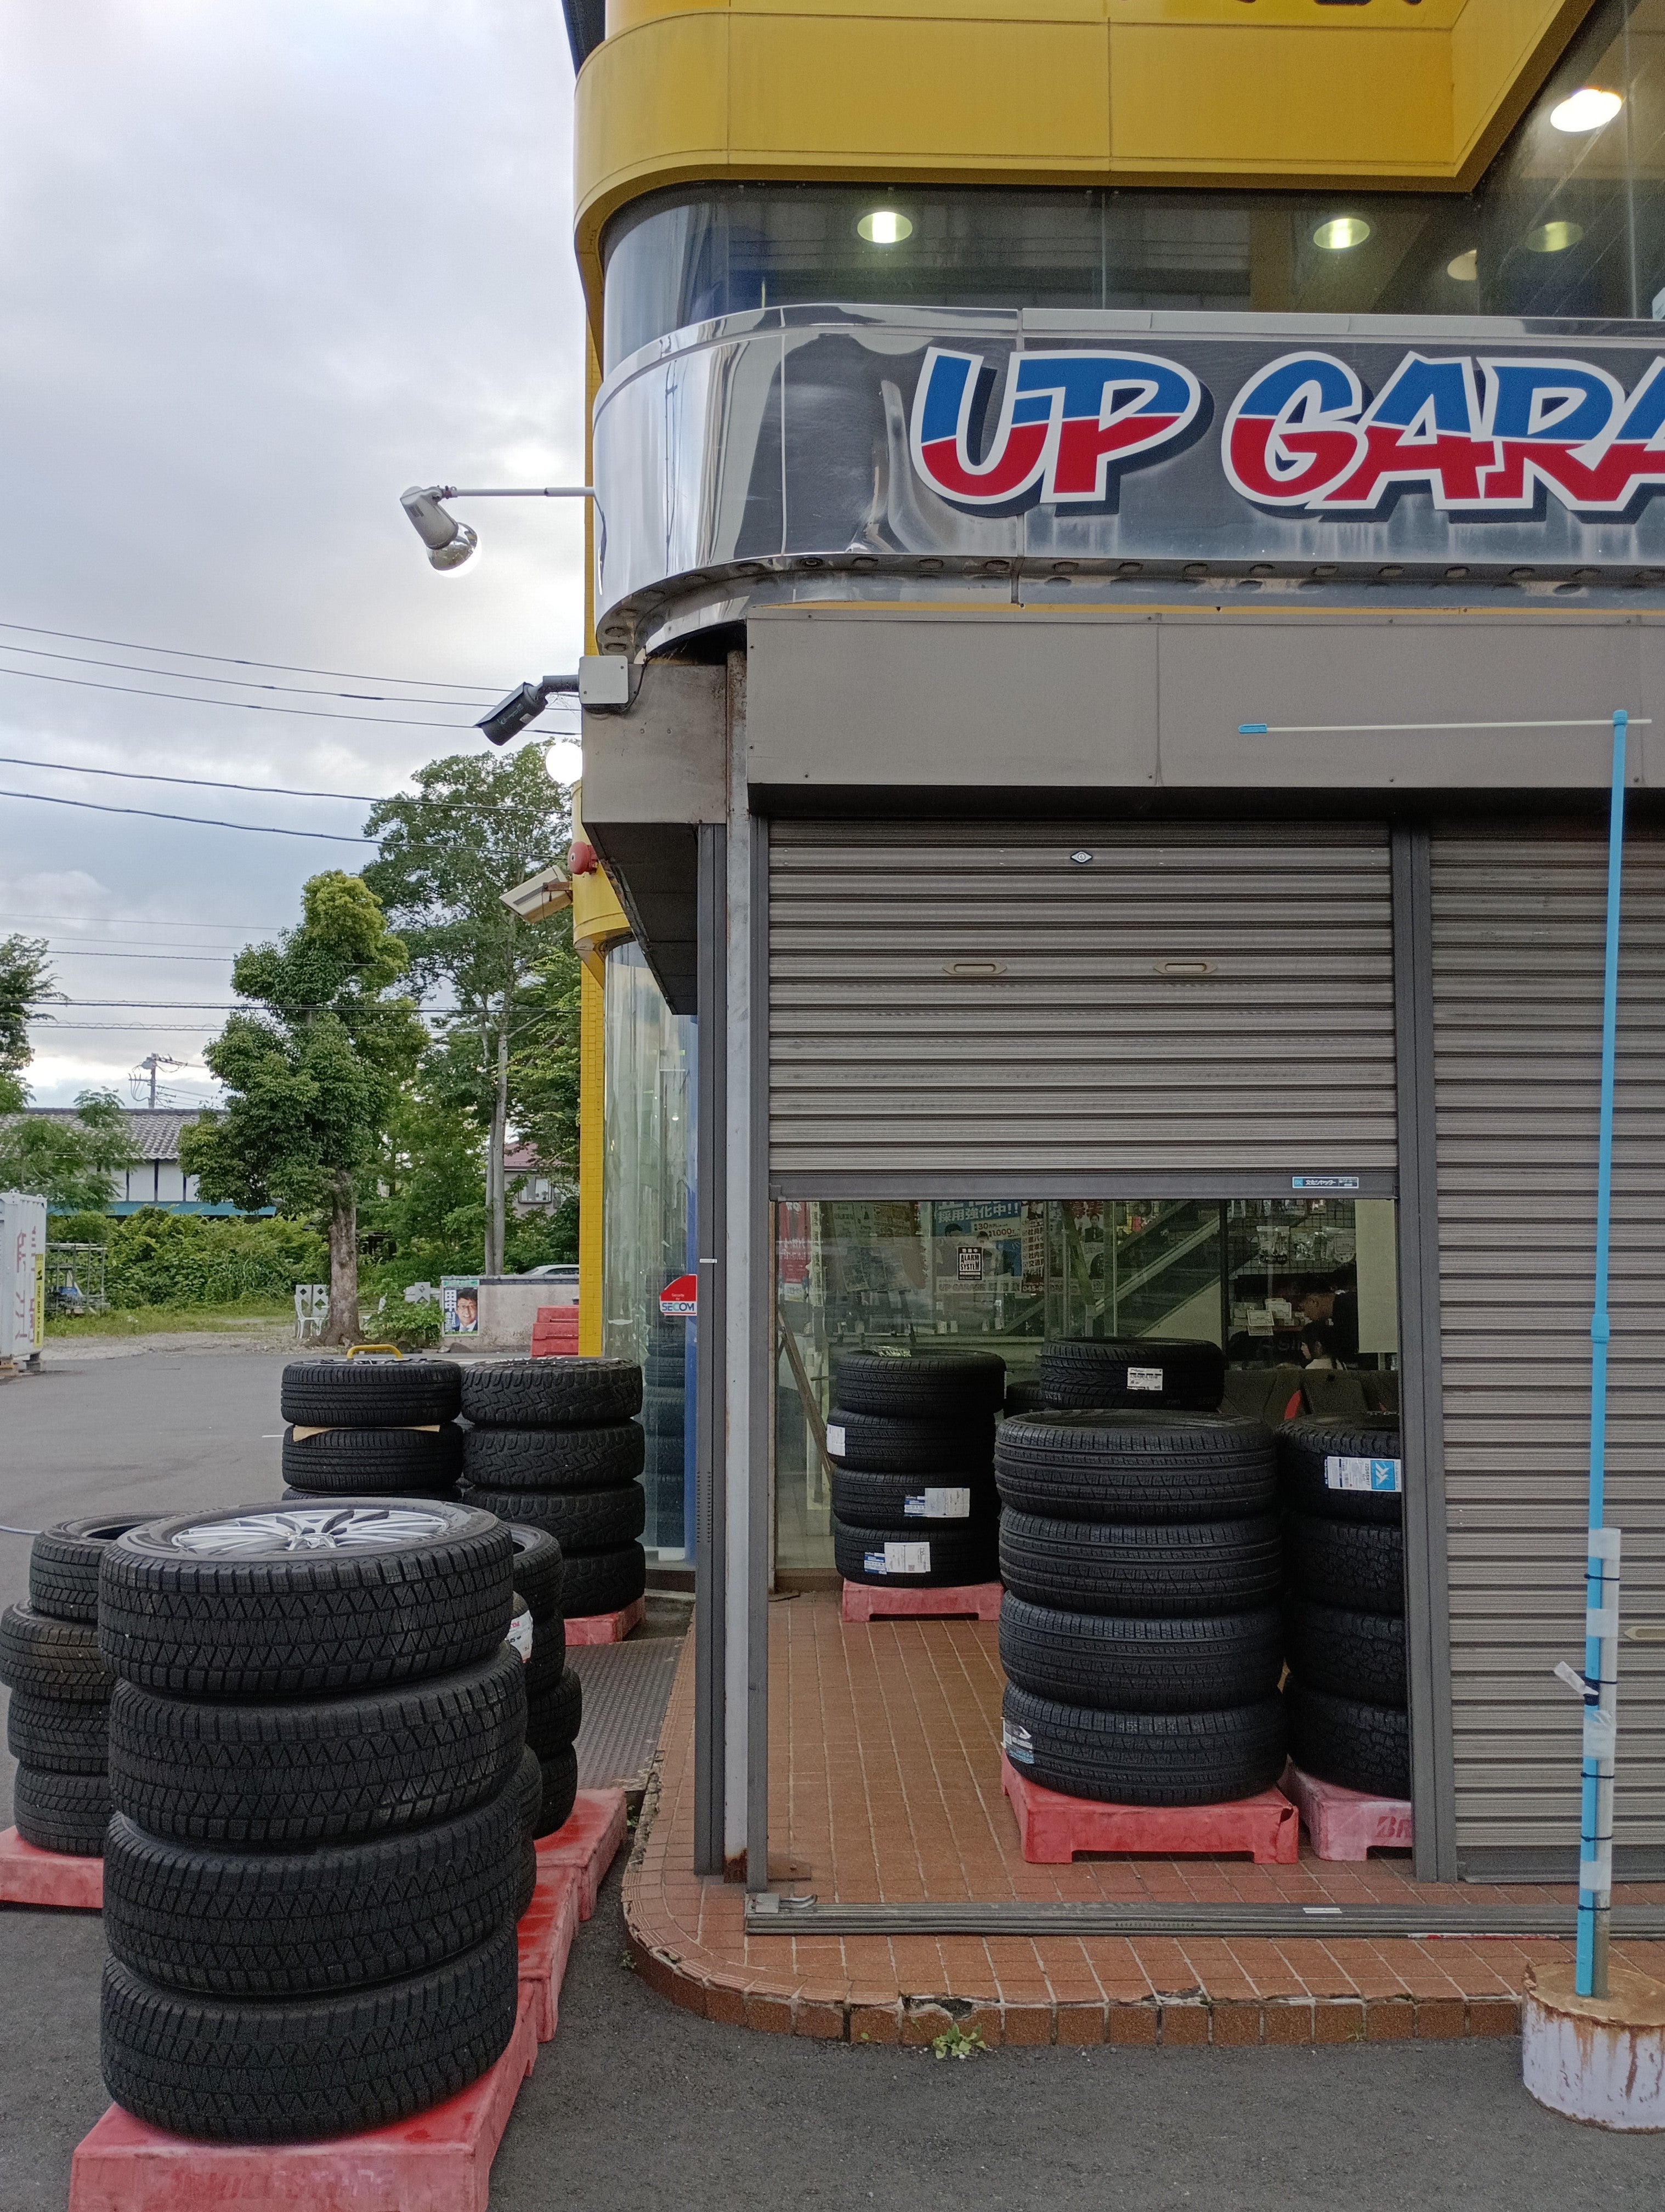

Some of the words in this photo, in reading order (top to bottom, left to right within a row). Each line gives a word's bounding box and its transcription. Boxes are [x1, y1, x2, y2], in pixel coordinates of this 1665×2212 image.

[909, 346, 1203, 505] UP
[961, 1254, 979, 1263] ALARM
[960, 1261, 979, 1270] SYSTEM
[662, 1302, 694, 1311] SECOM
